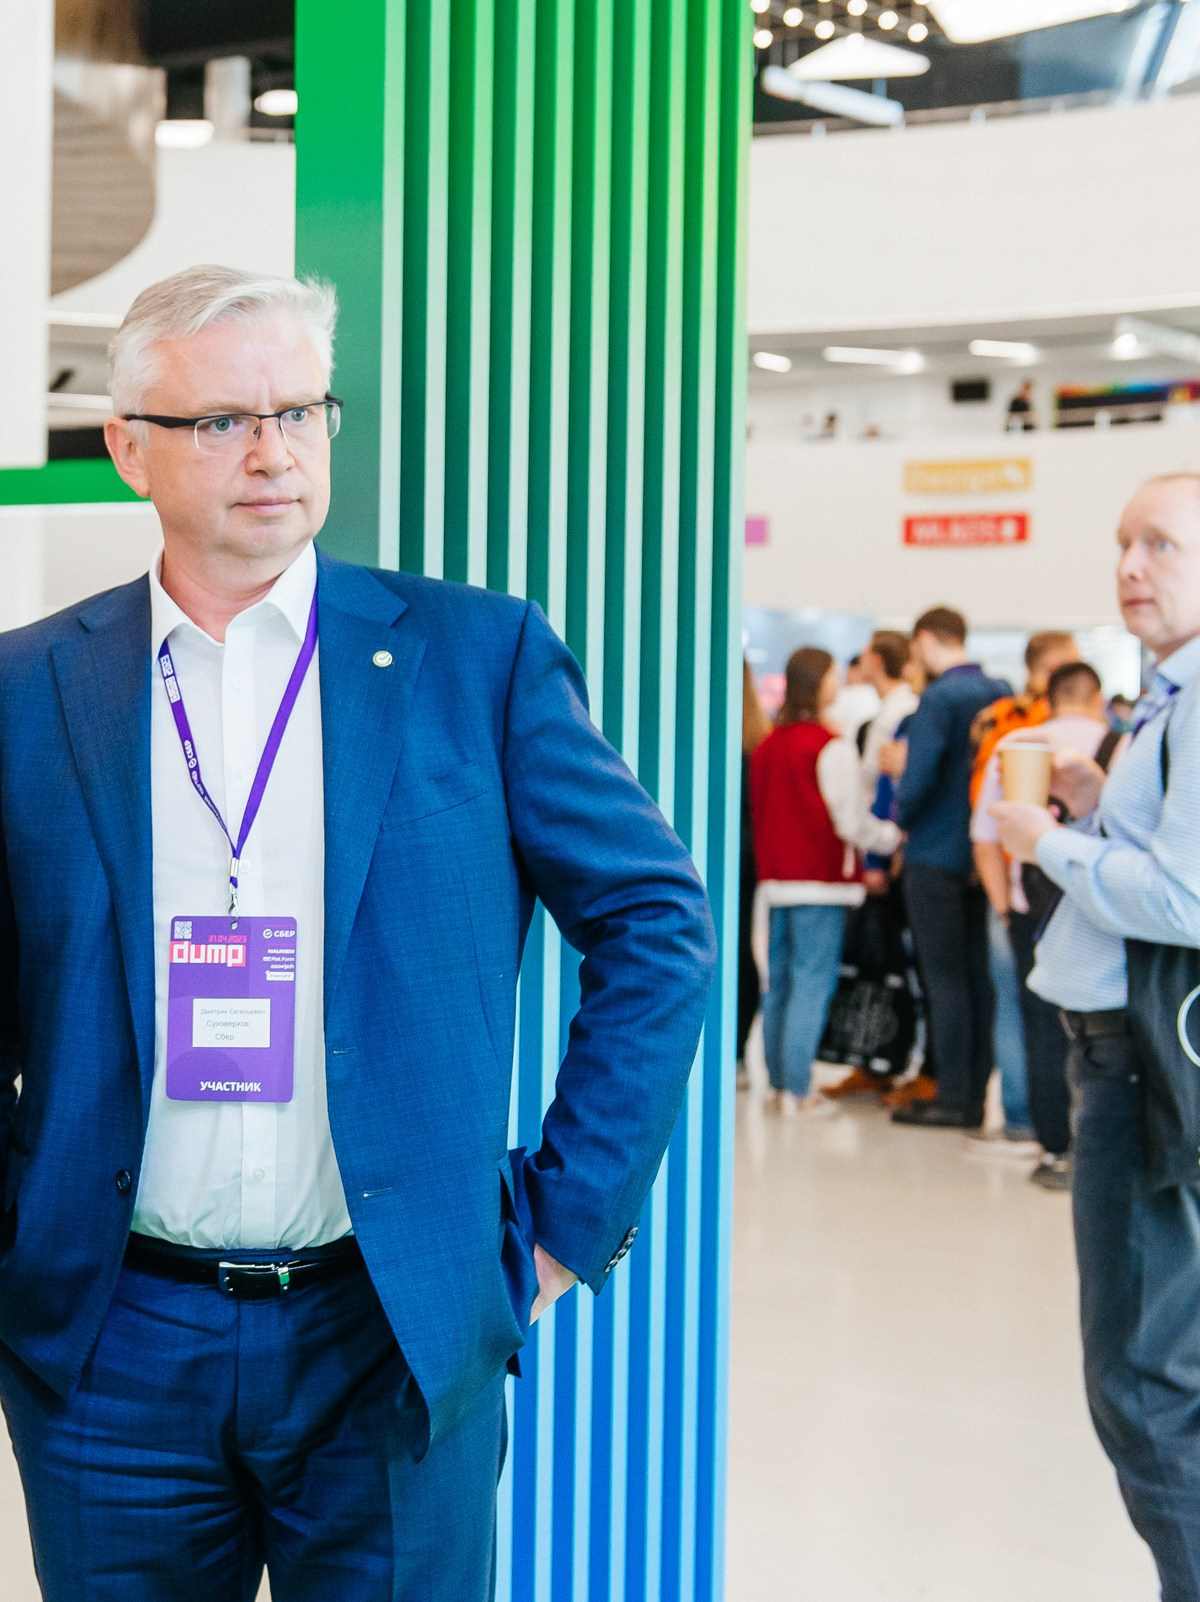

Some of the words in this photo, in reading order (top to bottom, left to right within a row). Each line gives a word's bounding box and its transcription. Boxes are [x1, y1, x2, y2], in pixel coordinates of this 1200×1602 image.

[273, 930, 296, 938] СБЕР
[208, 935, 247, 943] 21.04.2023
[172, 941, 244, 967] dump
[215, 1032, 234, 1041] Сбер
[200, 1081, 262, 1092] УЧАСТНИК
